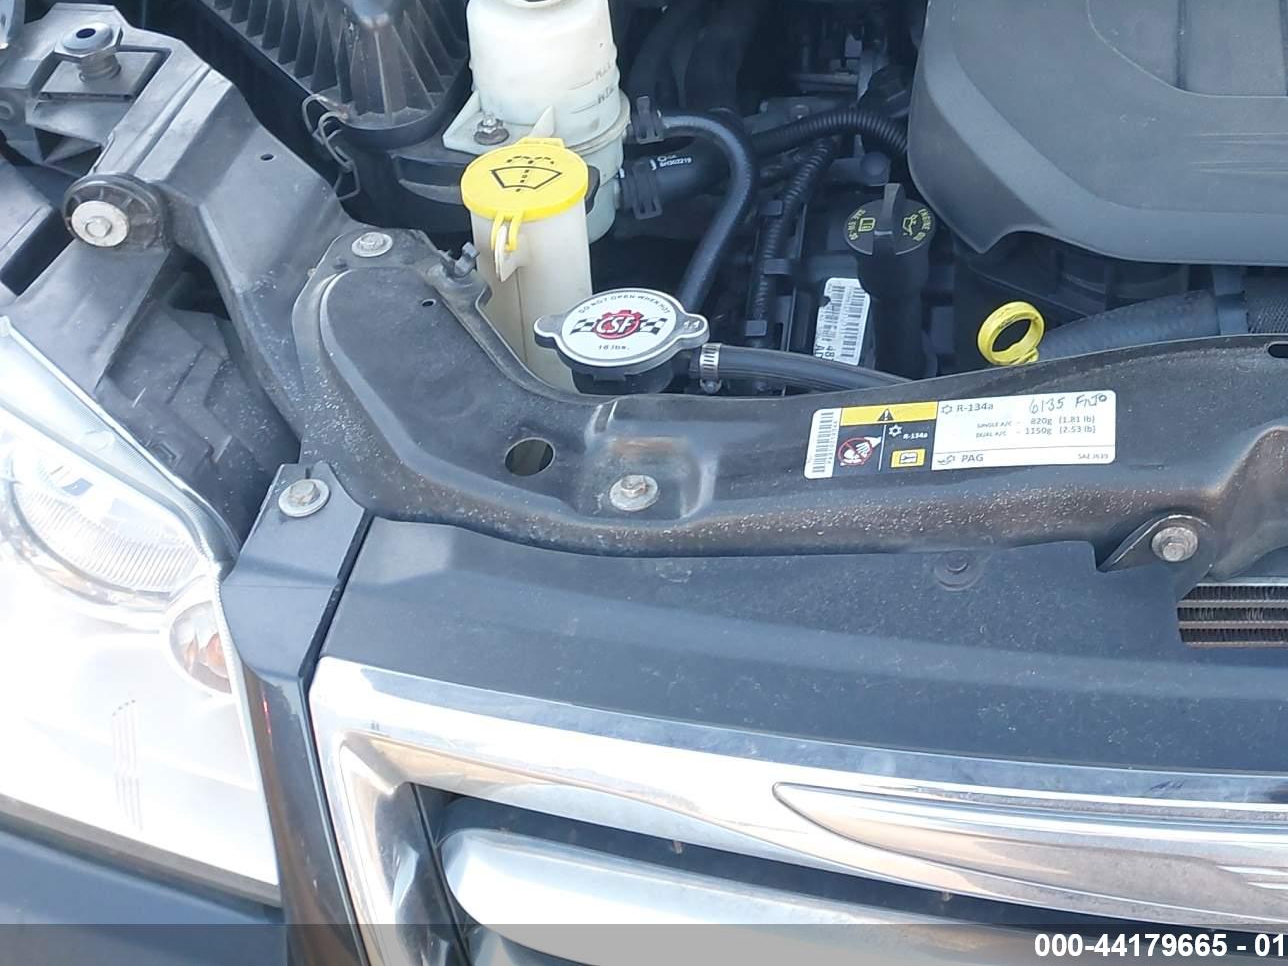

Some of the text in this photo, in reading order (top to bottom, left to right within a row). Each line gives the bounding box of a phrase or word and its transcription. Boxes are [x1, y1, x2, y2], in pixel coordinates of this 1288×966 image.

[596, 316, 634, 333] CSF
[956, 402, 994, 412] R-134a
[1029, 396, 1066, 414] 6135
[1025, 427, 1052, 436] 1150g
[961, 453, 984, 463] PAG
